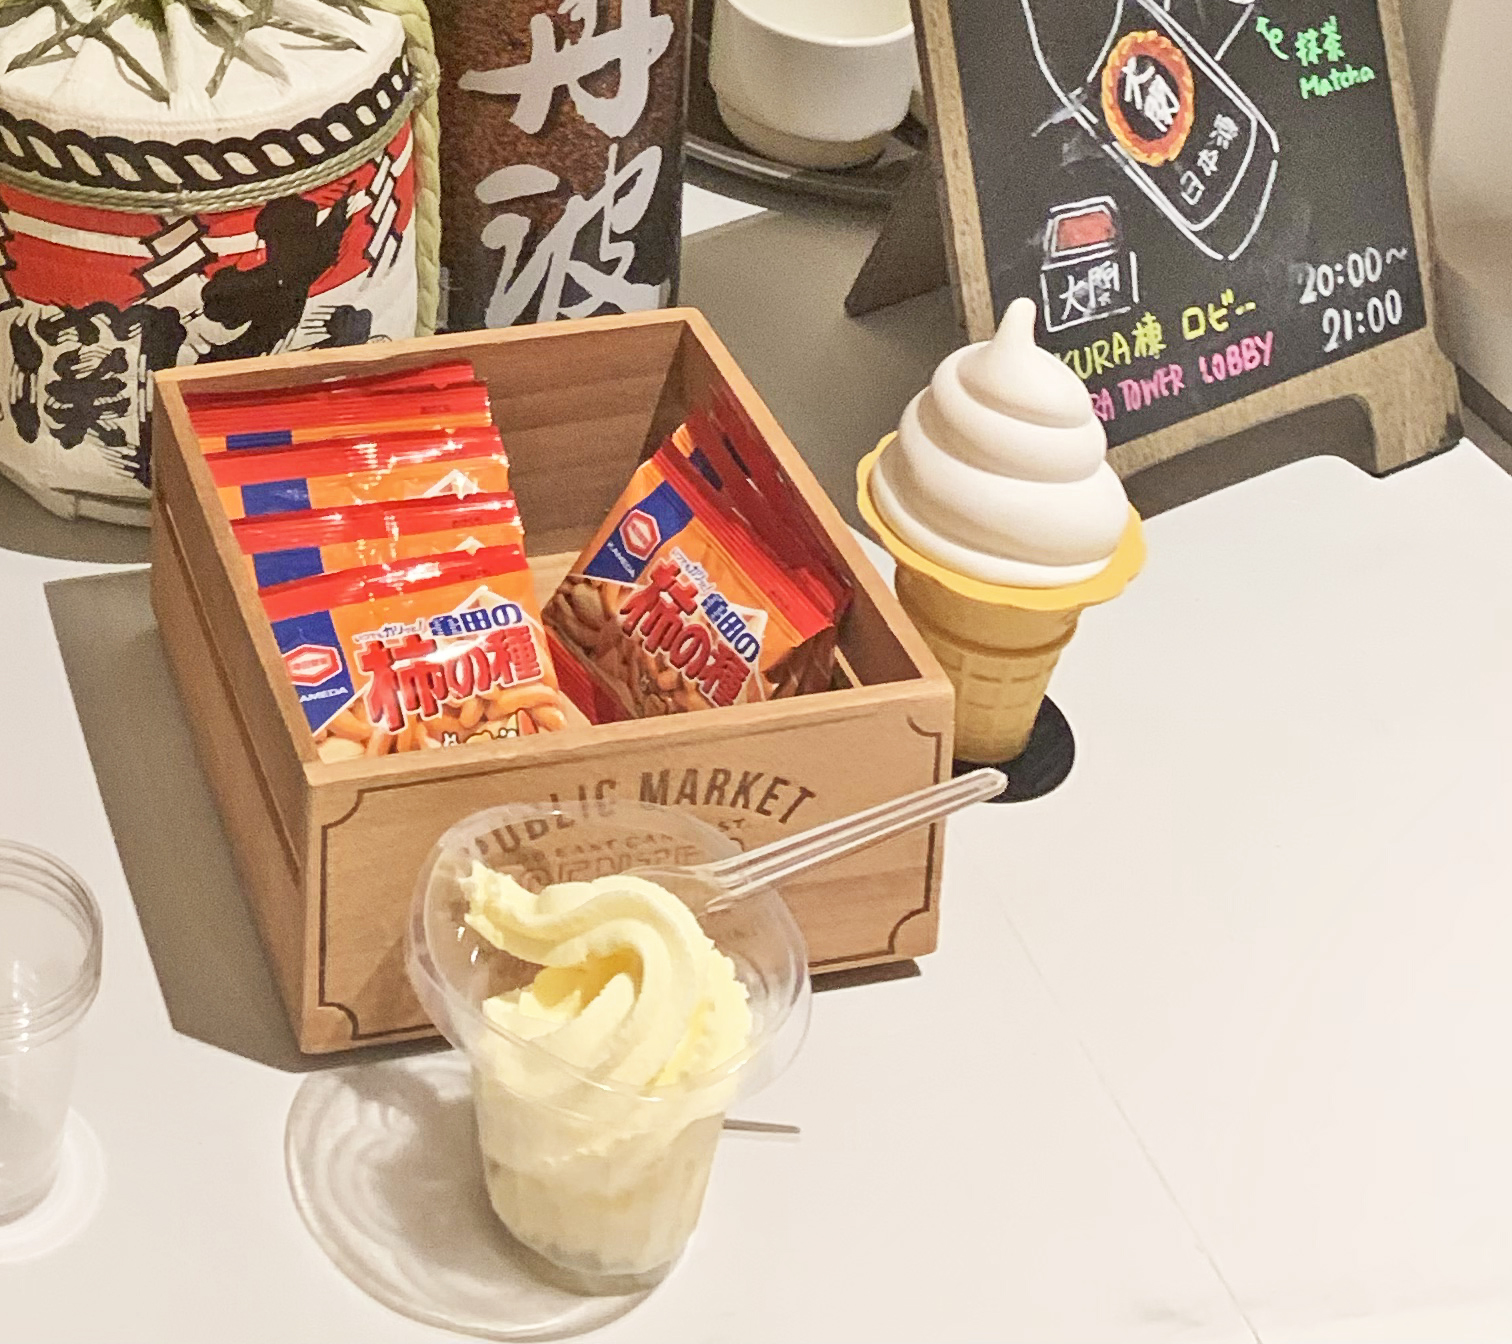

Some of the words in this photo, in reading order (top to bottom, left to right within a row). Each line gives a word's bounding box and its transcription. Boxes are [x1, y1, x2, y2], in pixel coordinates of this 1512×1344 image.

[1298, 63, 1377, 101] Matcha
[1181, 288, 1257, 341] ロビー
[1322, 288, 1404, 354] 21:00
[1117, 363, 1186, 413] TOWER
[1198, 330, 1276, 385] LOBBY
[429, 601, 524, 638] 亀田の
[619, 559, 752, 707] 柿の種
[299, 685, 350, 704] AMEDA
[359, 623, 543, 733] 柿の種
[639, 766, 818, 826] MARKET
